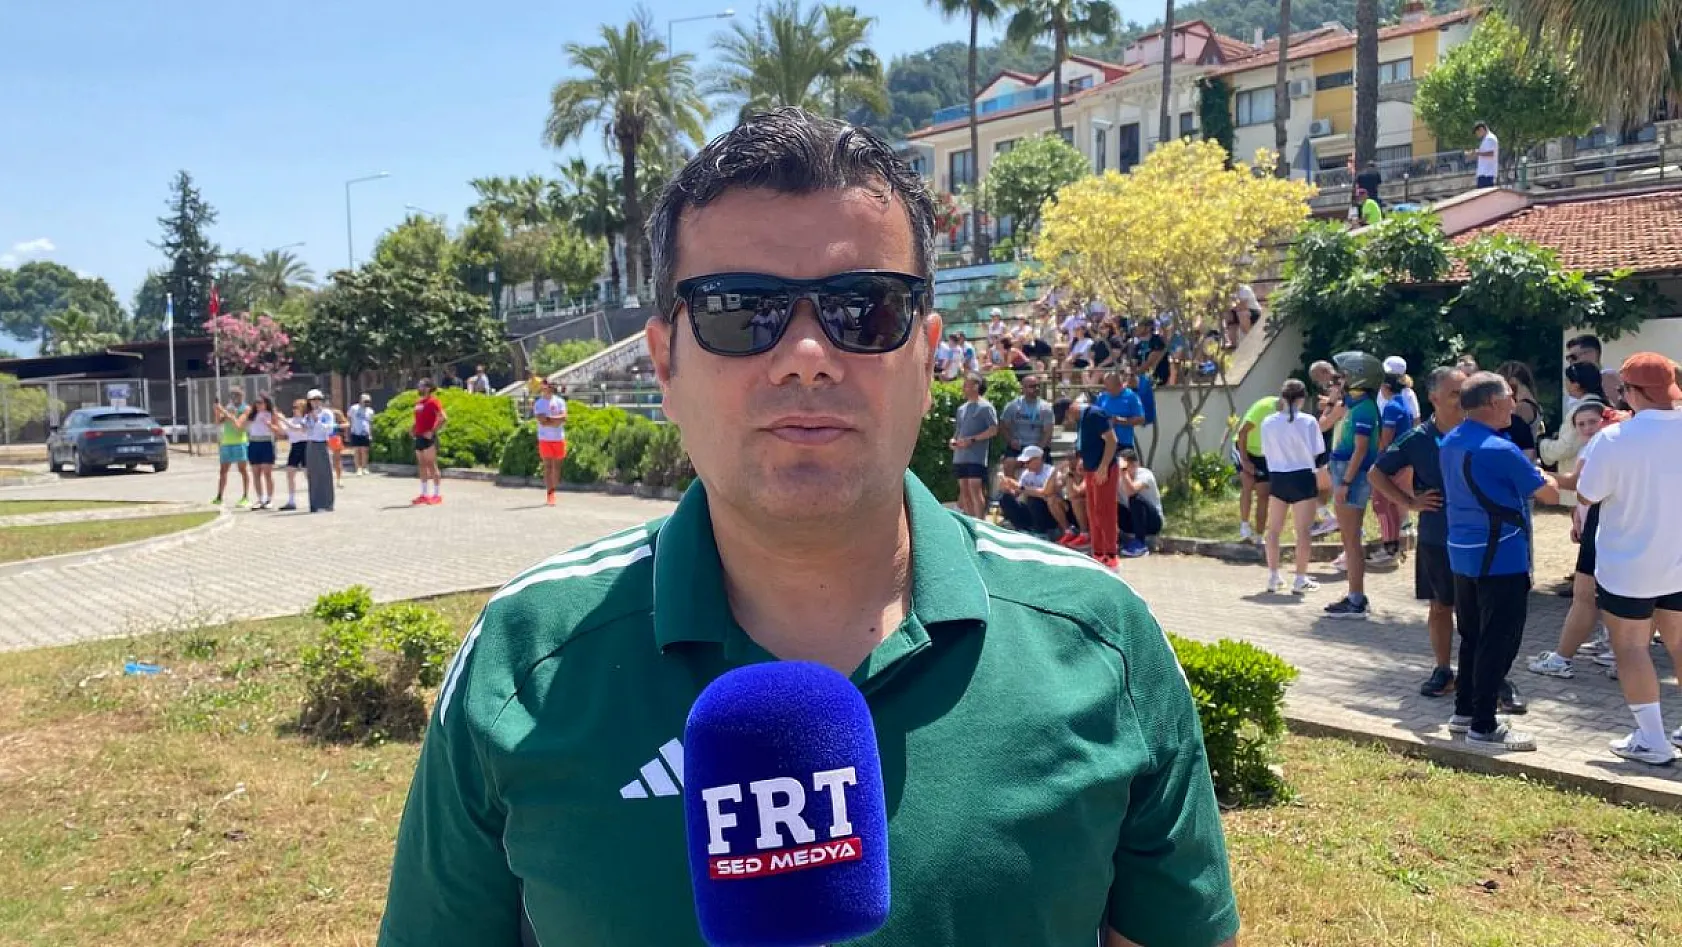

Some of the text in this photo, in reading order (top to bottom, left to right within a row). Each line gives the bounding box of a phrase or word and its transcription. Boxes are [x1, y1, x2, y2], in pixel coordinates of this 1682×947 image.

[702, 766, 857, 854] FRT
[716, 842, 856, 875] SED MEDYA
